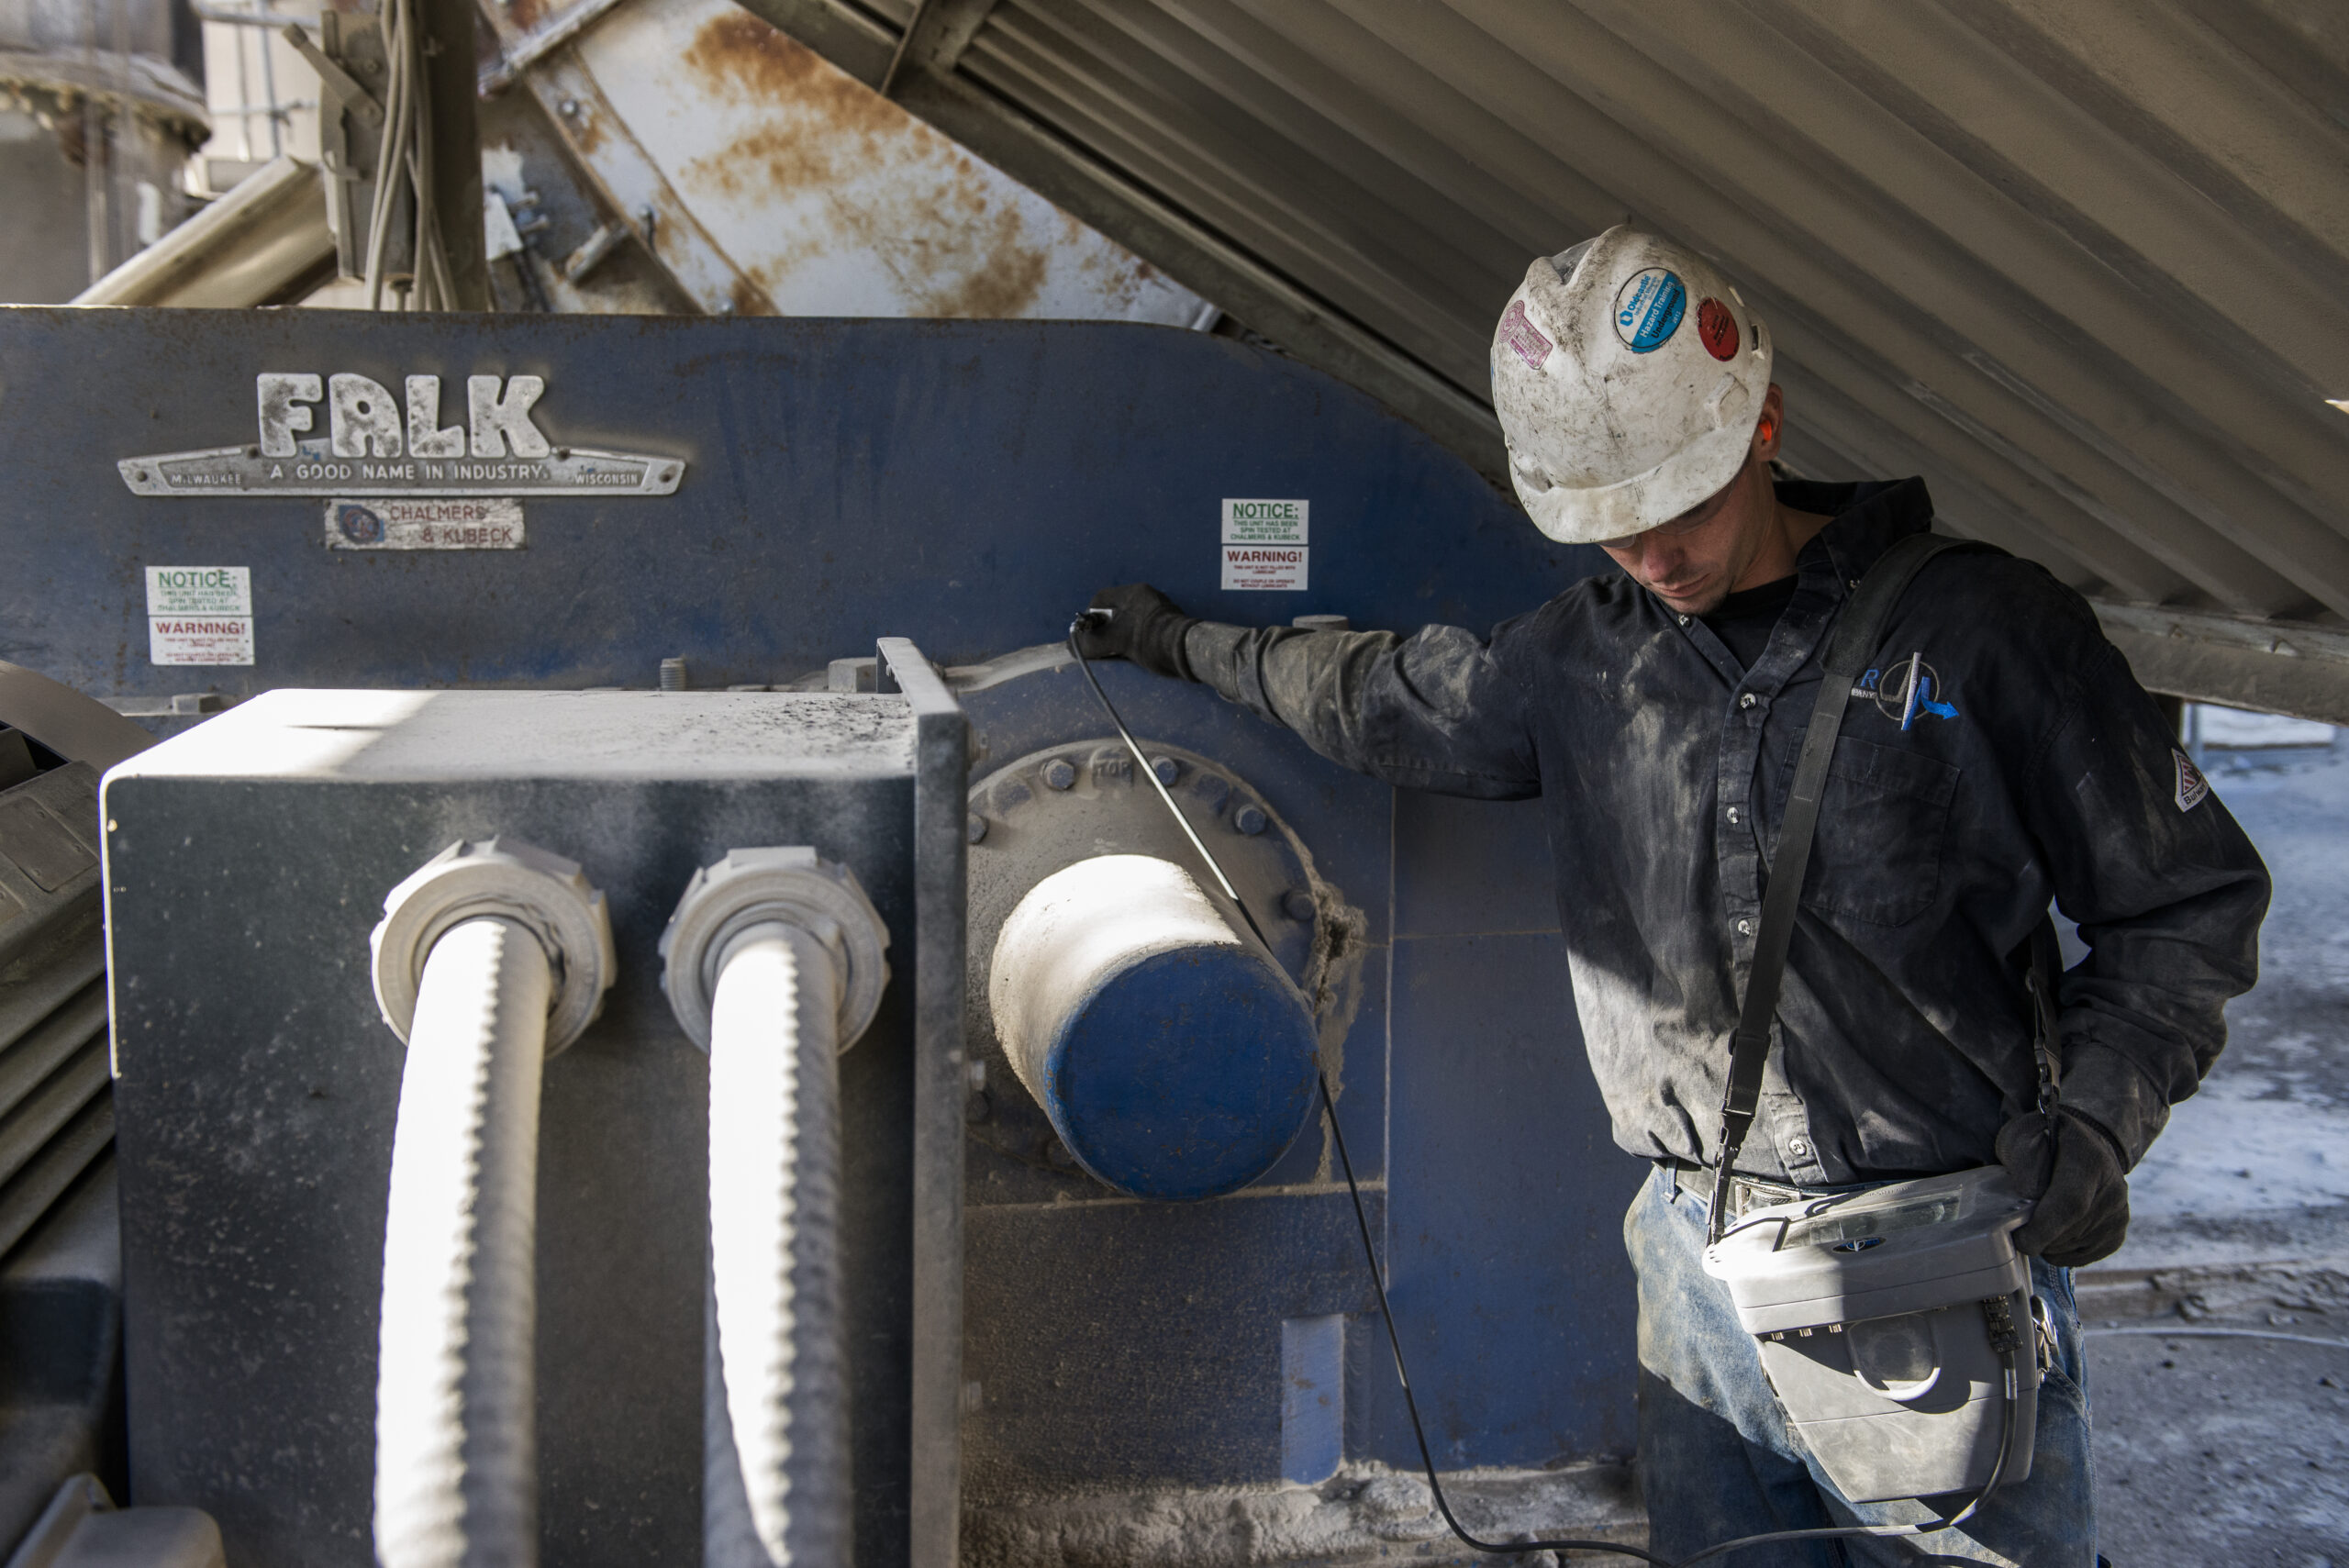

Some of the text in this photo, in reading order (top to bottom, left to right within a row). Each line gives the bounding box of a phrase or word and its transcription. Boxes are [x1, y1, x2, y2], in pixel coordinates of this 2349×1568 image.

[1628, 274, 1651, 311] Oldcastle
[1640, 308, 1660, 338] Hazard
[1654, 281, 1675, 308] Training
[1652, 288, 1681, 338] Underground
[257, 373, 551, 458] FALK
[270, 464, 284, 479] A
[296, 464, 351, 479] GOOD
[362, 464, 414, 479] NAME
[426, 464, 443, 479] IN
[574, 473, 638, 485] WISCONSIN
[390, 506, 487, 521] CHALMERS
[1233, 503, 1299, 518] NOTICE:
[422, 528, 513, 543] & KUBECK
[1227, 550, 1303, 562] WARNING!
[158, 572, 237, 588] NOTICE:
[156, 622, 246, 635] WARNING!
